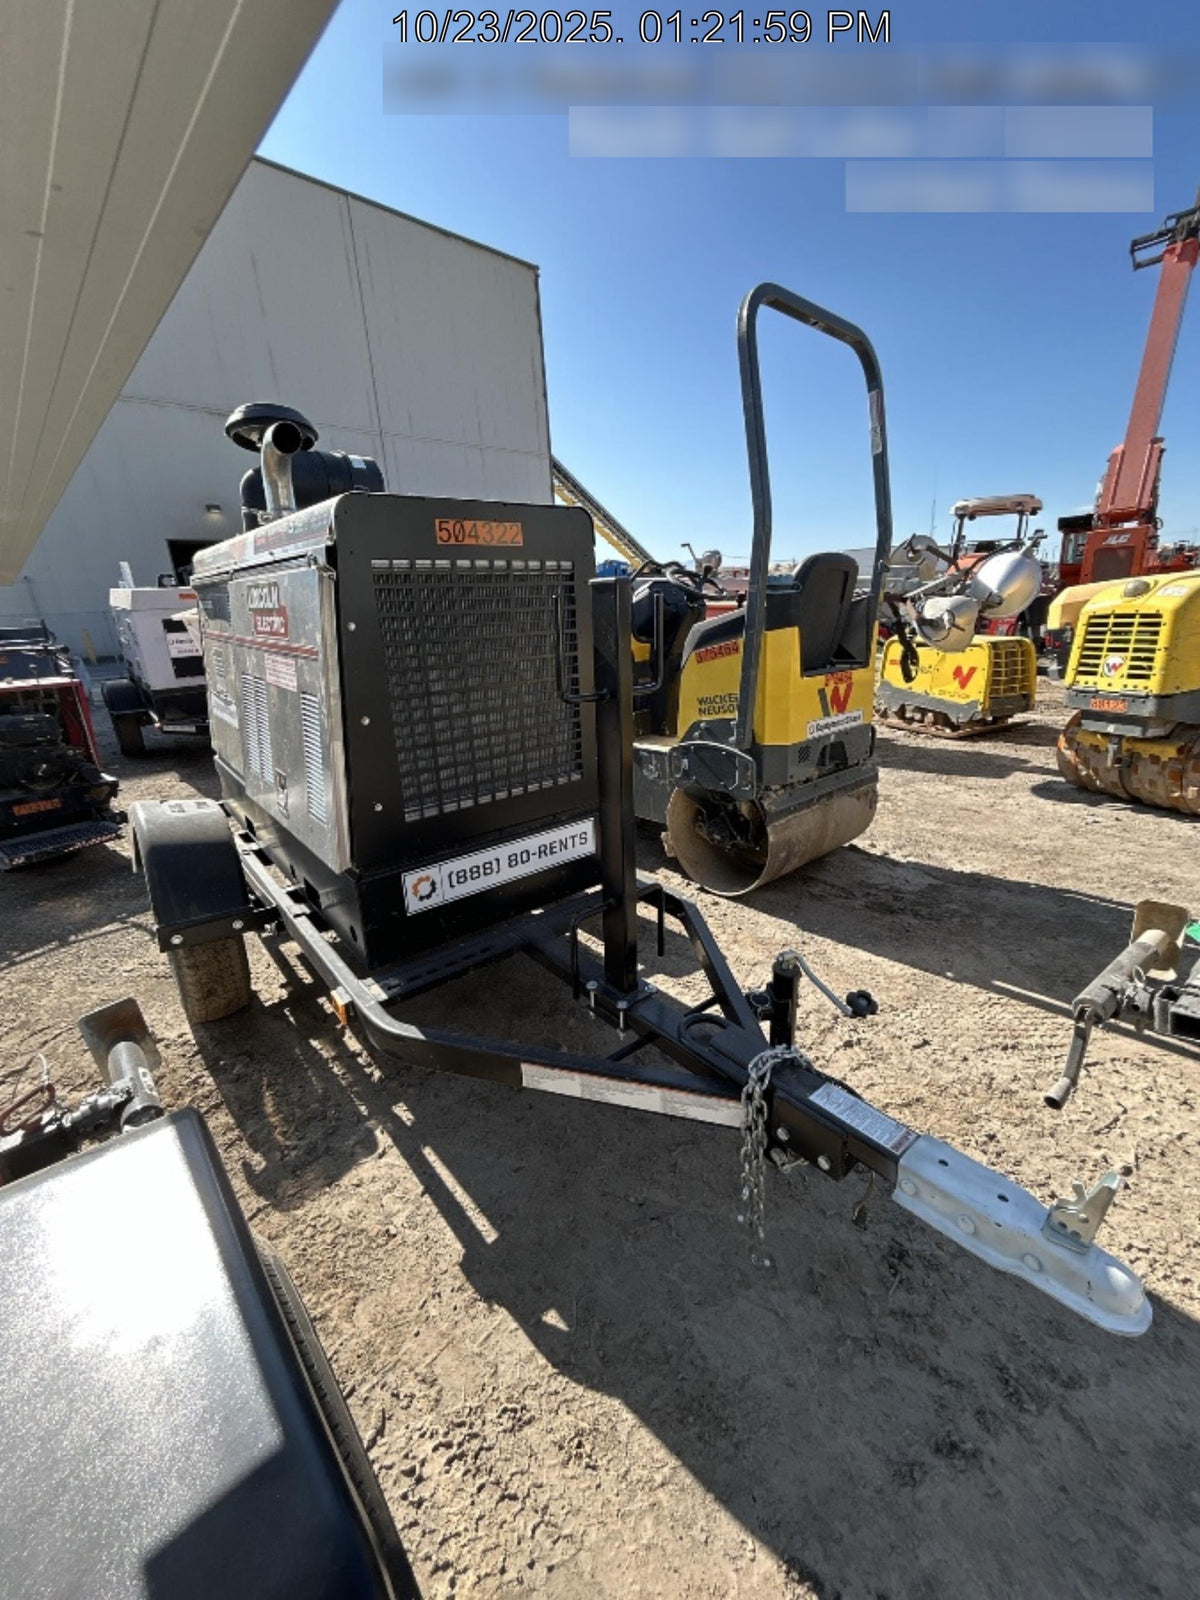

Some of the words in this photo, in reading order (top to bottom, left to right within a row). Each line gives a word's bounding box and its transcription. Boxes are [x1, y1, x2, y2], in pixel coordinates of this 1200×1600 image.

[438, 520, 522, 545] 504322
[697, 702, 739, 716] NEUSO
[507, 831, 588, 869] 80-RENTS
